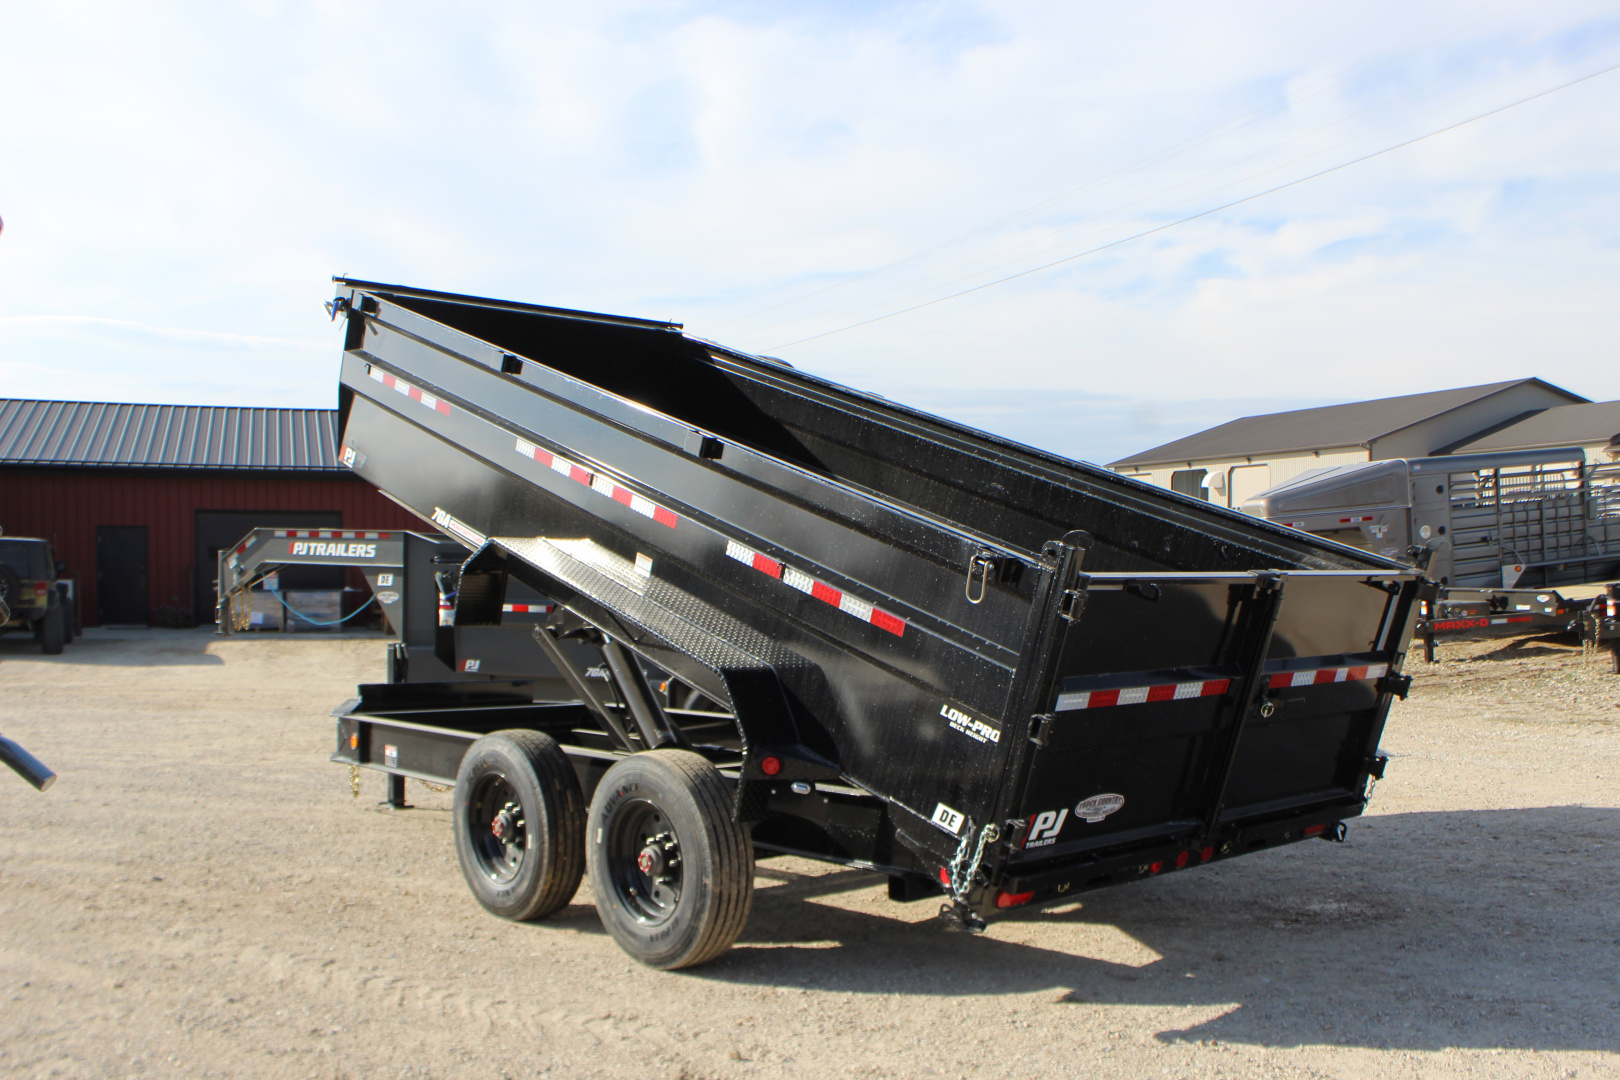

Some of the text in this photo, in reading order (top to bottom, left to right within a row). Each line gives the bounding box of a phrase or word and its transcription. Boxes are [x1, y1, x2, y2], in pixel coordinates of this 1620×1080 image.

[431, 506, 452, 529] 7GA
[380, 575, 390, 584] DE
[1434, 618, 1488, 631] MAXX-D
[465, 659, 481, 670] PJ
[940, 704, 1001, 743] LOW-PRO
[949, 721, 988, 744] DECK HEIGHT
[939, 809, 956, 827] DE
[1028, 808, 1069, 841] PJ
[1025, 837, 1057, 849] TRAILERS
